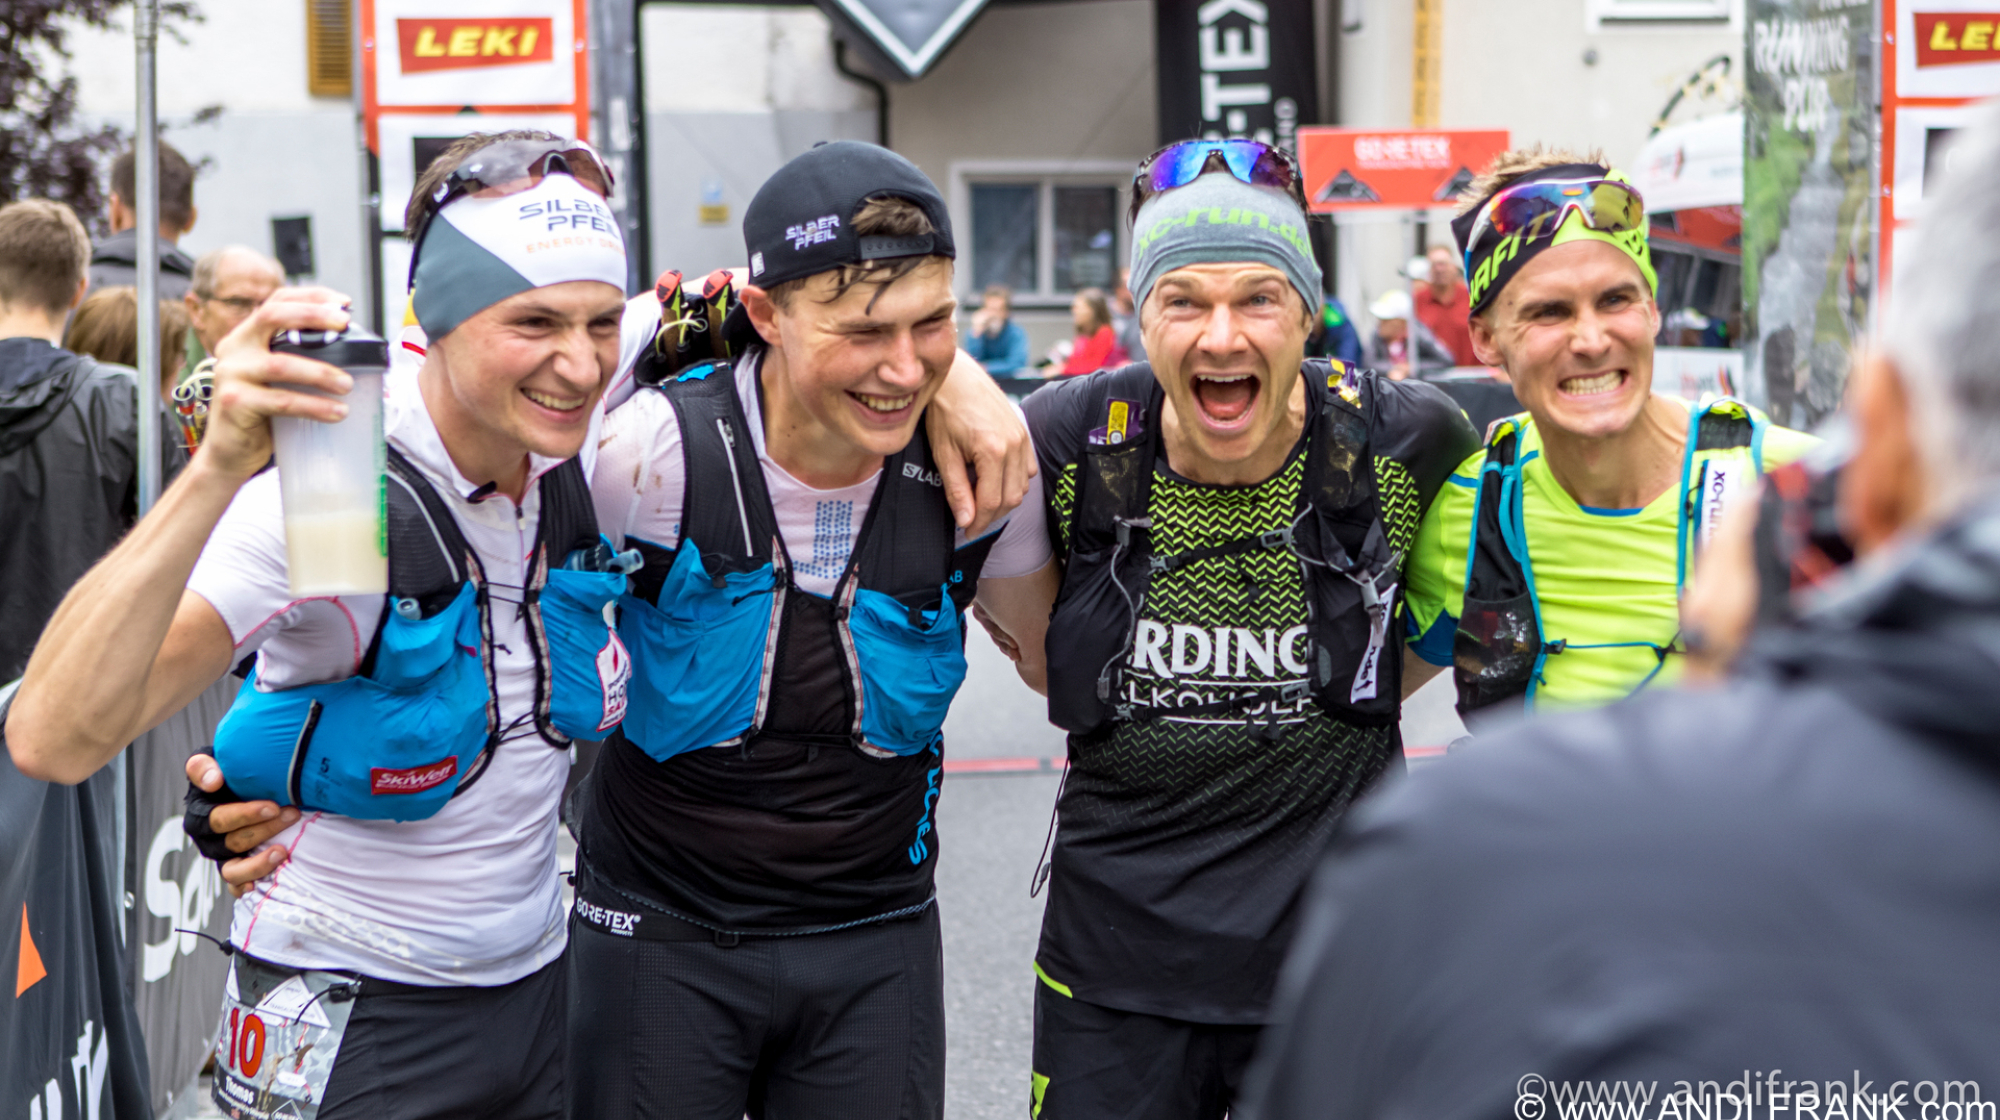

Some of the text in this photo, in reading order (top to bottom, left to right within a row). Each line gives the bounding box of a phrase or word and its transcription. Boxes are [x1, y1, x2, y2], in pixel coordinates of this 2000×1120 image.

[413, 25, 539, 58] LEKI
[794, 229, 837, 251] PFEIL
[228, 1006, 267, 1079] 10
